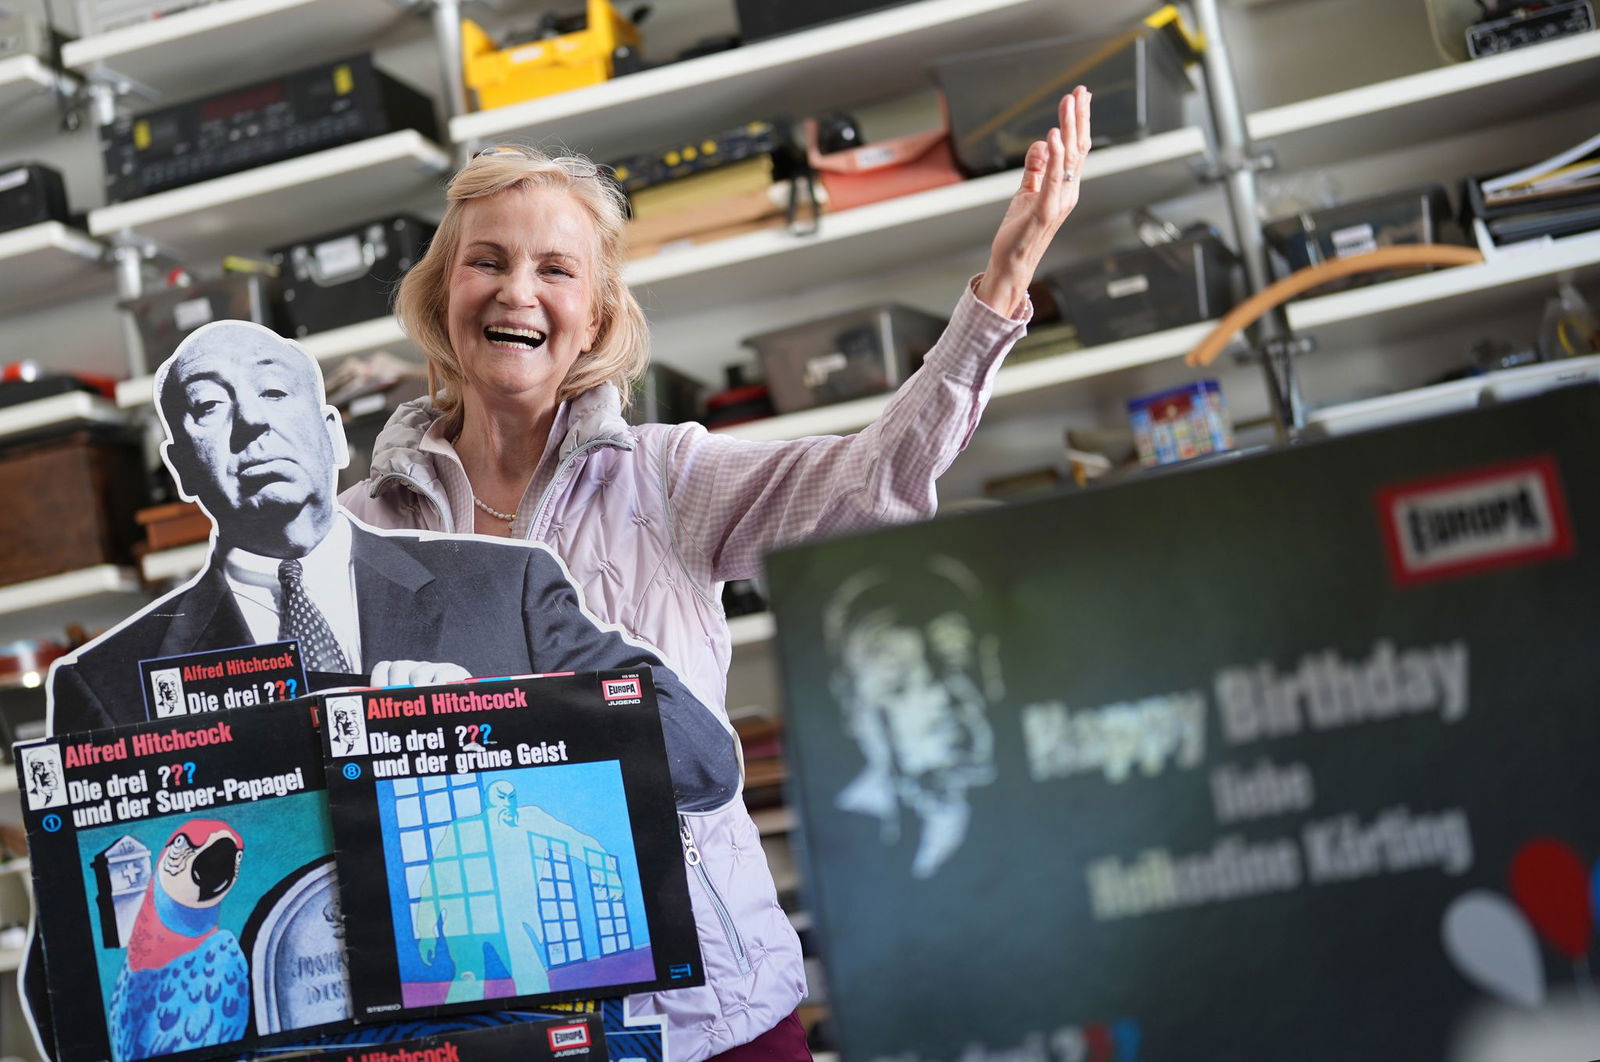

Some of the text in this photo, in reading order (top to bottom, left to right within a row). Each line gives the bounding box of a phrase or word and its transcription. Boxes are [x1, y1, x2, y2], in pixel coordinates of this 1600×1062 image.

[183, 653, 294, 682] Alfred Hitchcock
[187, 678, 297, 714] Die drei ???
[367, 688, 528, 720] Alfred Hitchcock
[608, 684, 636, 695] EUROPA
[1021, 638, 1470, 783] Happy Birthday
[65, 722, 233, 769] Alfred Hitchcock
[369, 724, 491, 755] Die drei ???
[373, 755, 410, 778] und
[414, 752, 448, 774] der
[516, 741, 569, 763] Geist
[68, 762, 196, 804] Die drei ???
[73, 768, 305, 828] und der Super-Papagei
[366, 1004, 401, 1014] STEREO
[554, 1030, 584, 1045] EUROPA
